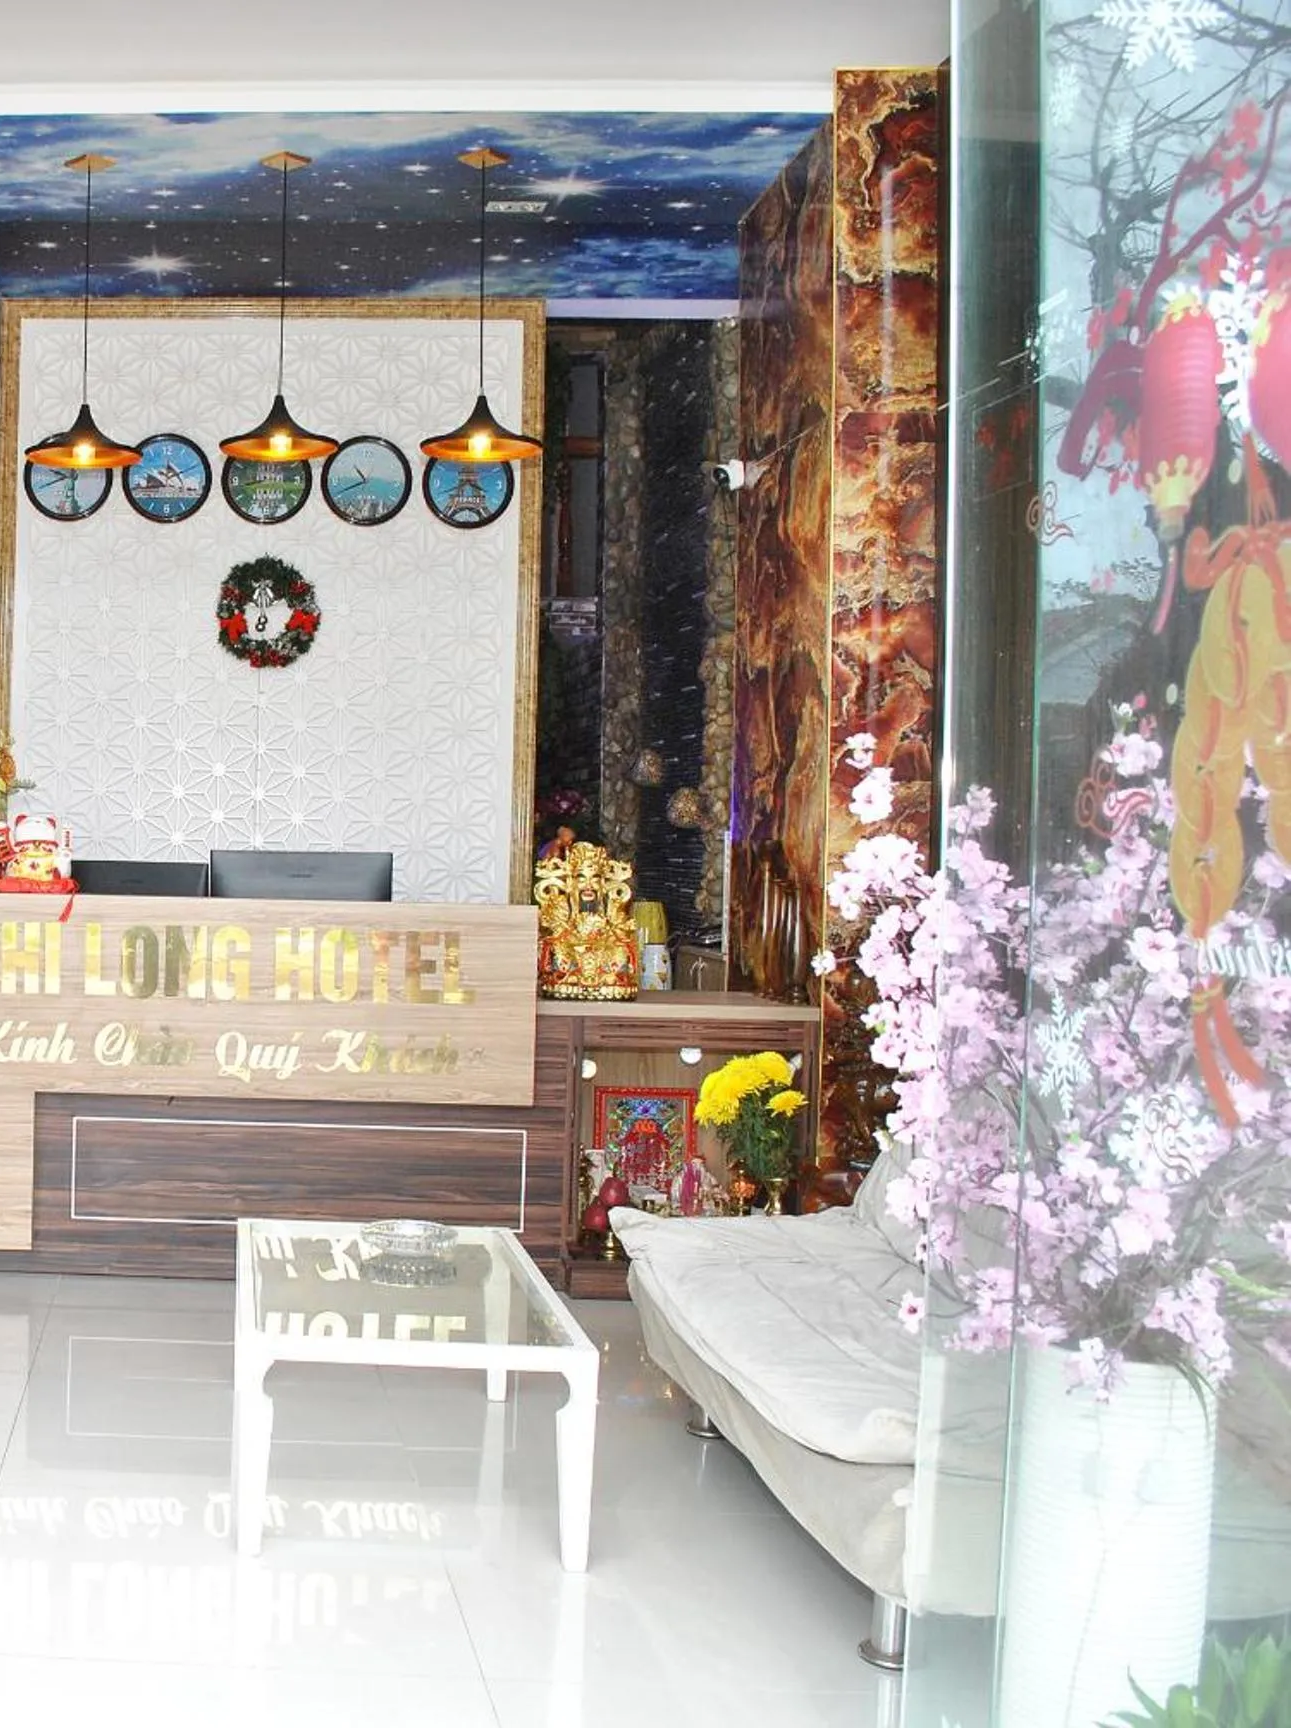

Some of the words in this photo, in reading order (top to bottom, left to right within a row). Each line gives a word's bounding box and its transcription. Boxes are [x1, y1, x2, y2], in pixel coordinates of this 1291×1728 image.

[84, 922, 251, 1001] LONG
[275, 925, 476, 1005] HOTEL
[215, 1031, 304, 1084] Quý
